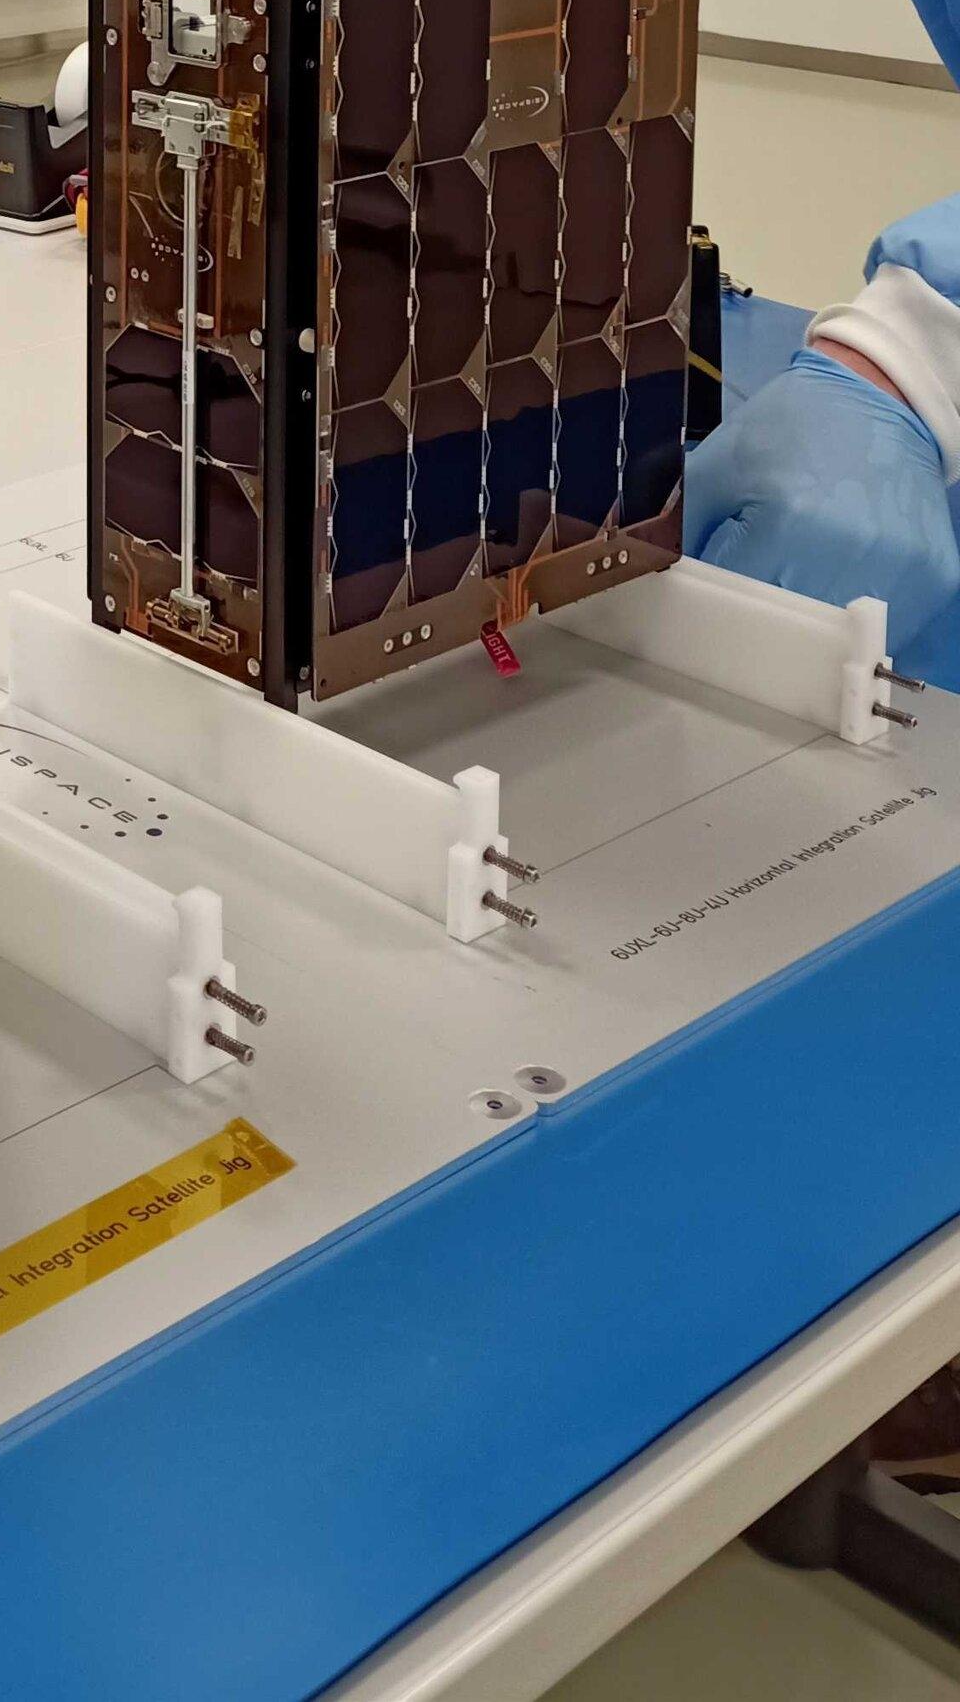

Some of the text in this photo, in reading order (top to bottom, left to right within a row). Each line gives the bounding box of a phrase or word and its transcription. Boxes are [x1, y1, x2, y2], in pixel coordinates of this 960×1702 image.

[610, 785, 938, 961] 6UXL-6U-8U-4U Horizontal Integration Satellite Jig
[9, 1218, 129, 1287] Integration
[126, 1169, 217, 1224] Satellite
[222, 1152, 253, 1177] Jig
